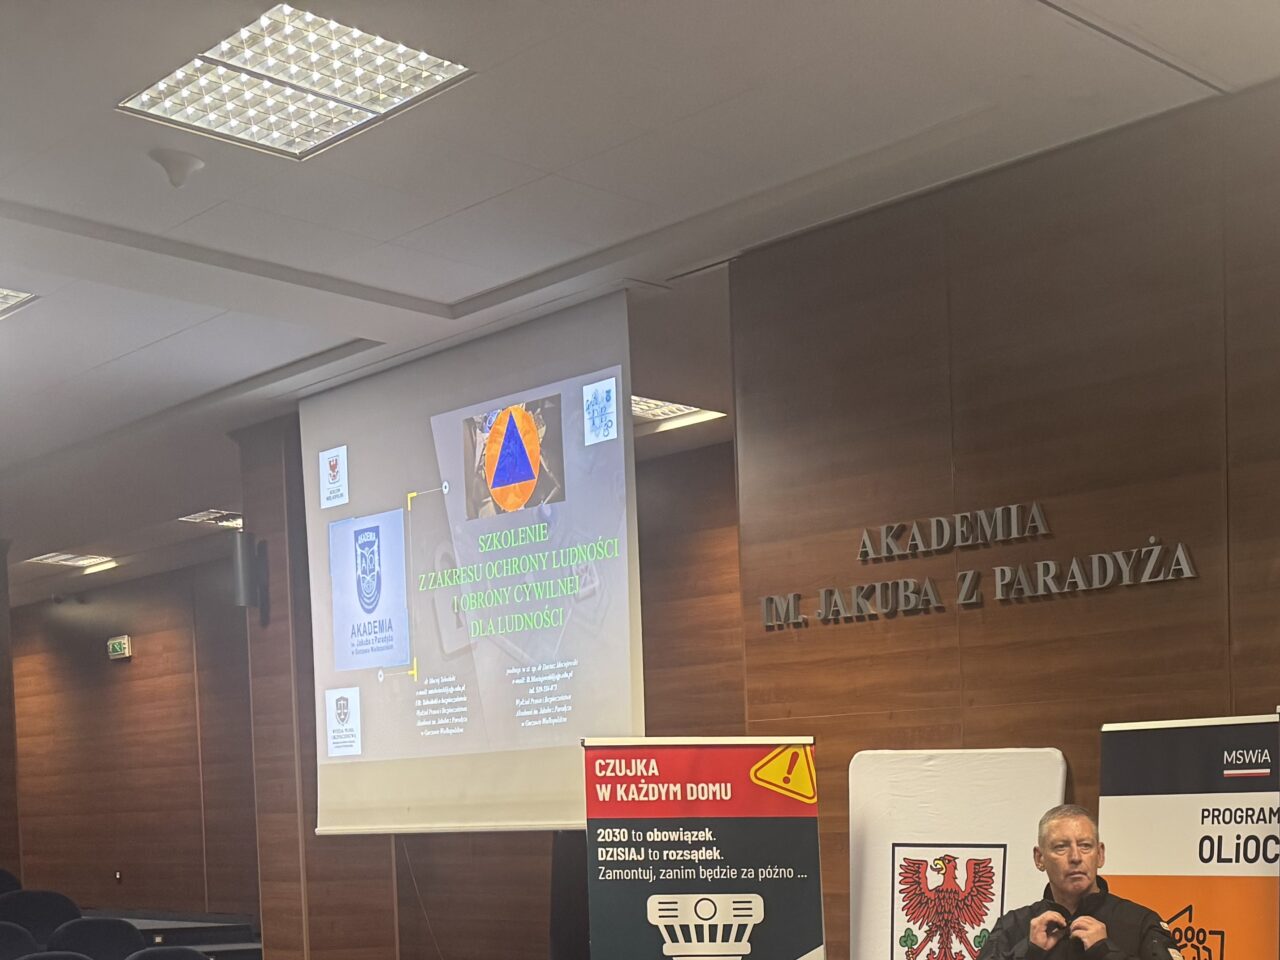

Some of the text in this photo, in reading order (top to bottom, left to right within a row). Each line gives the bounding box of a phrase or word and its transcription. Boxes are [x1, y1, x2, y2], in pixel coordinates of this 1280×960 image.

[478, 523, 549, 553] SZKOLENIE
[856, 502, 1051, 561] AKADEMIA
[418, 536, 620, 591] Z ZAKRESU OCHRONY LUDNOŚCI
[761, 536, 1197, 628] IM. JAKUBA Z PARADYŻA
[460, 587, 512, 612] OBRONY
[513, 575, 580, 603] CYWILNEJ
[351, 618, 393, 638] AKADEMIA
[471, 604, 564, 638] DLA LUDNOŚCI
[595, 758, 659, 777] CZUJKA
[1223, 749, 1271, 765] MSWiA
[596, 779, 732, 801] W KAŻDYM DOMU
[1201, 807, 1280, 825] PROGRAM
[597, 828, 717, 845] 2030 to obowiązek.
[598, 847, 724, 863] DZISIAJ to rozsądek.
[1199, 834, 1280, 864] OLiOC
[598, 866, 657, 883] Zamontuj,
[659, 866, 696, 880] zanim
[699, 866, 738, 882] będzie
[741, 868, 755, 879] za
[758, 866, 794, 882] późno
